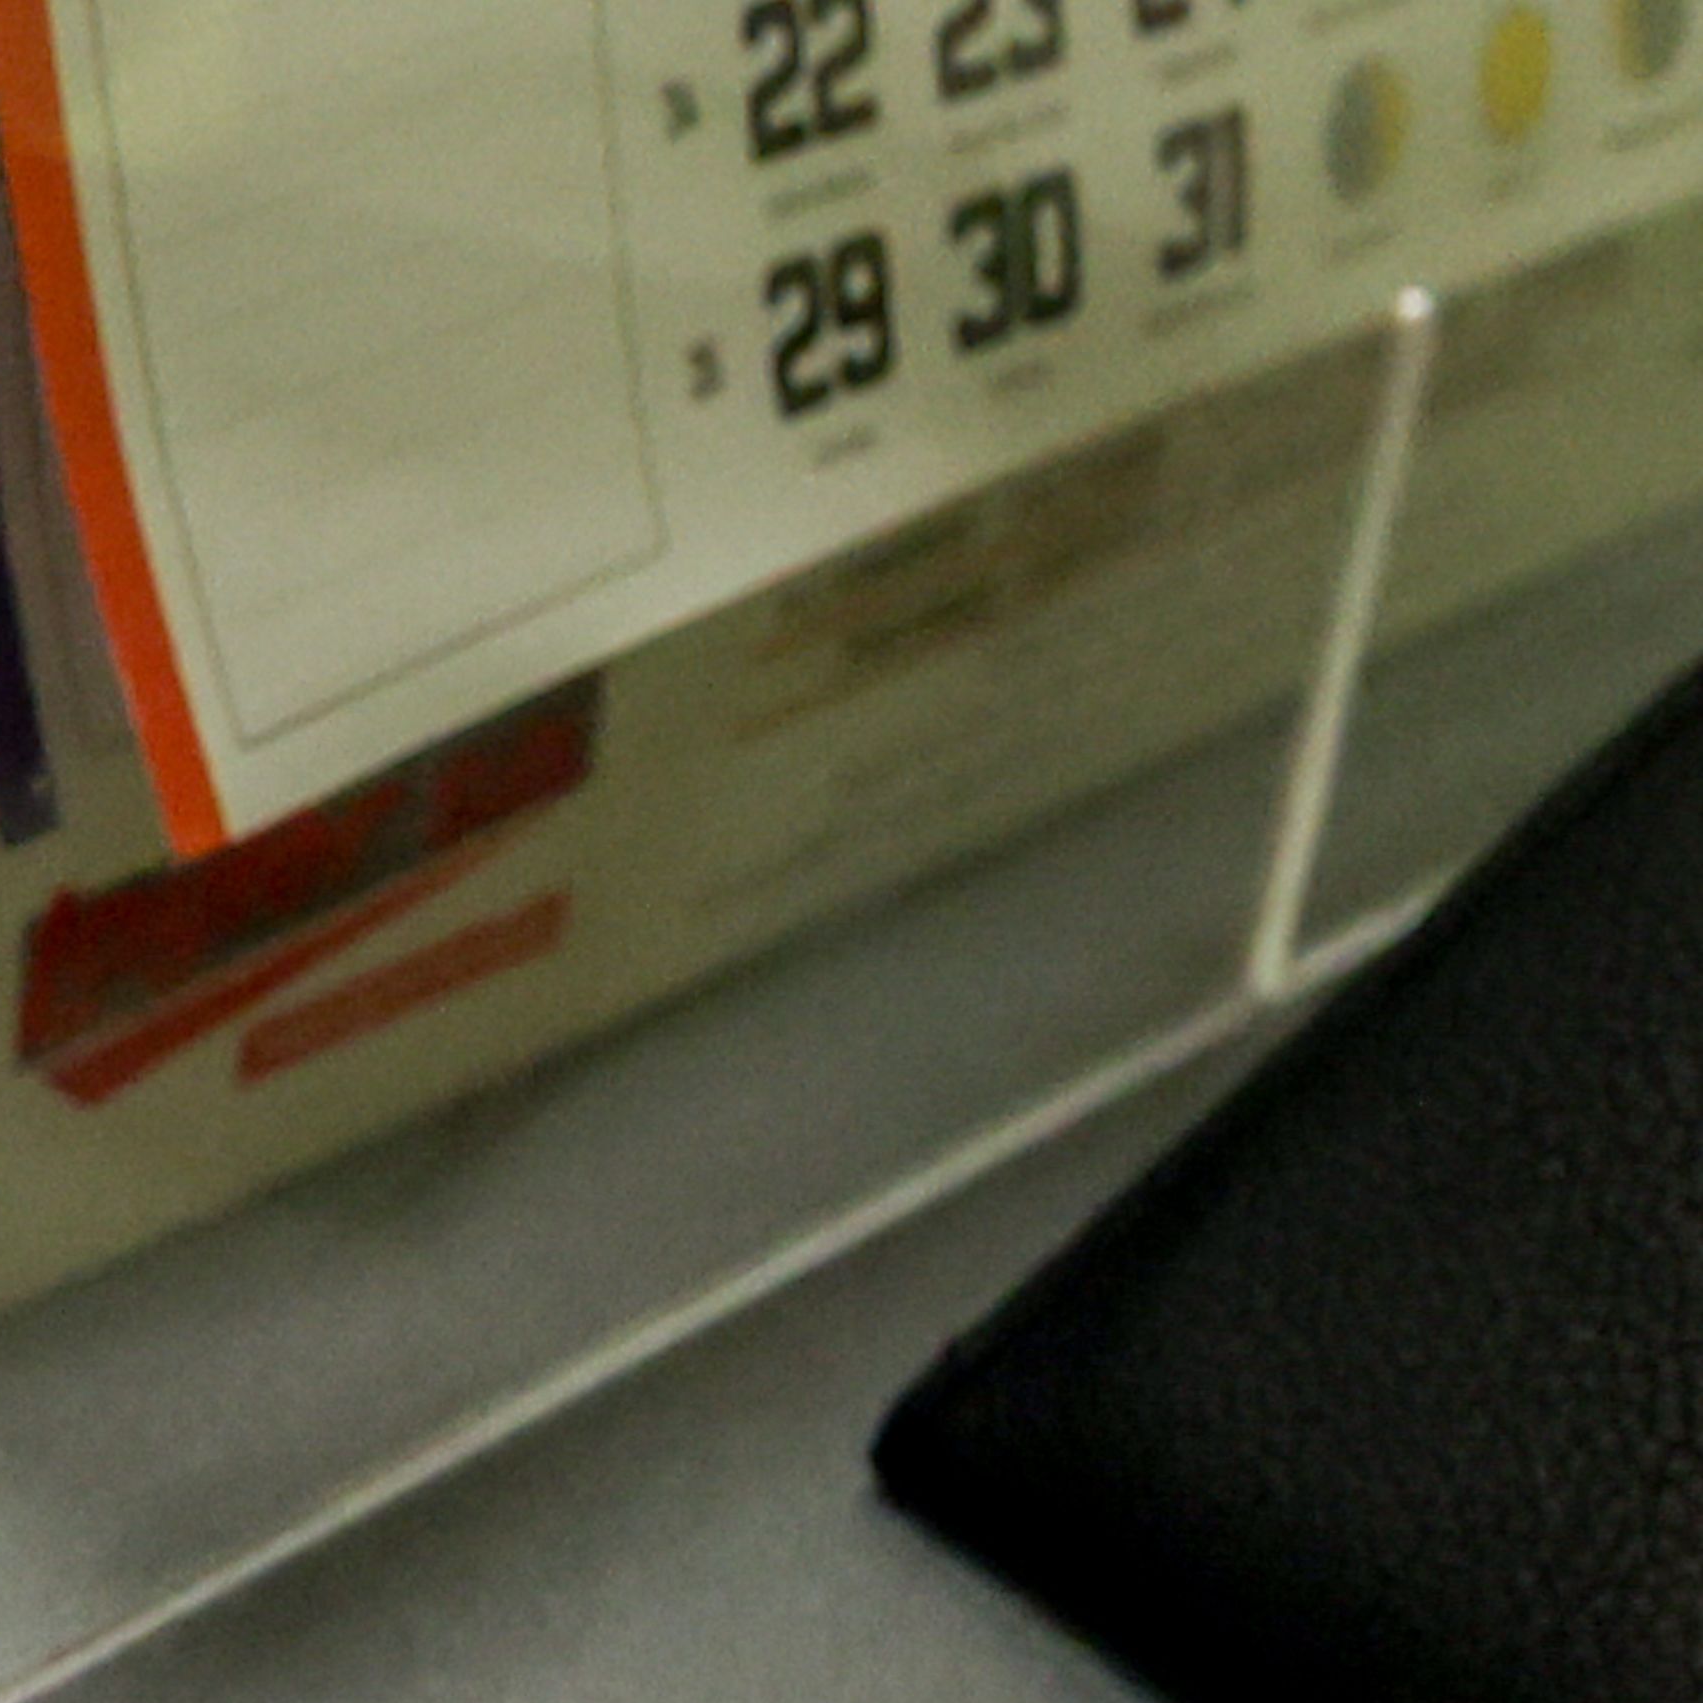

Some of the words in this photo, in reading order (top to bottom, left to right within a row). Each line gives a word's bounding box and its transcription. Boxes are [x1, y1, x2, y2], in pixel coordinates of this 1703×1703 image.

[742, 0, 876, 162] 22
[762, 228, 898, 424] 29
[948, 166, 1084, 354] 30
[1154, 105, 1251, 284] 31
